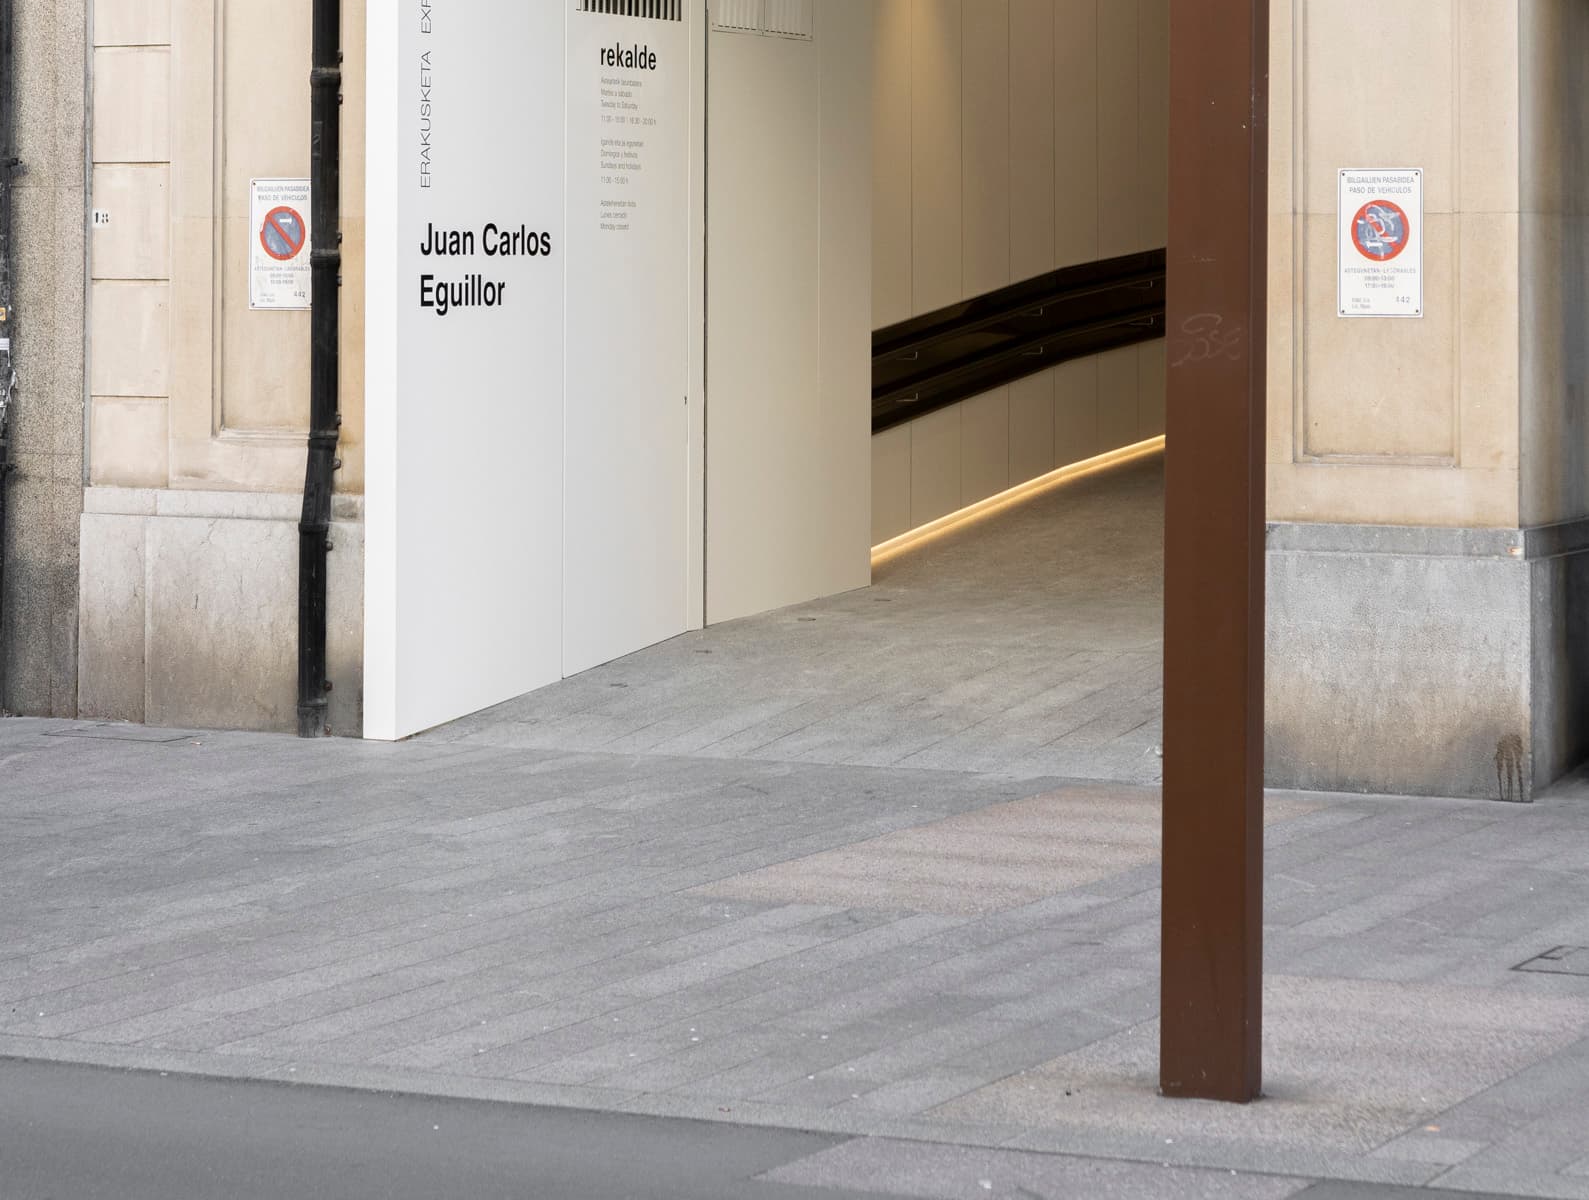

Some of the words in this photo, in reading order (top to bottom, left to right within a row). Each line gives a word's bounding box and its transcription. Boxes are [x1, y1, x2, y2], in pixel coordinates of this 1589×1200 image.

[600, 42, 657, 71] rekalde
[420, 50, 432, 189] ERAKUSKETA
[420, 222, 475, 256] Juan
[482, 222, 551, 257] Carlos
[420, 273, 505, 316] Eguillor
